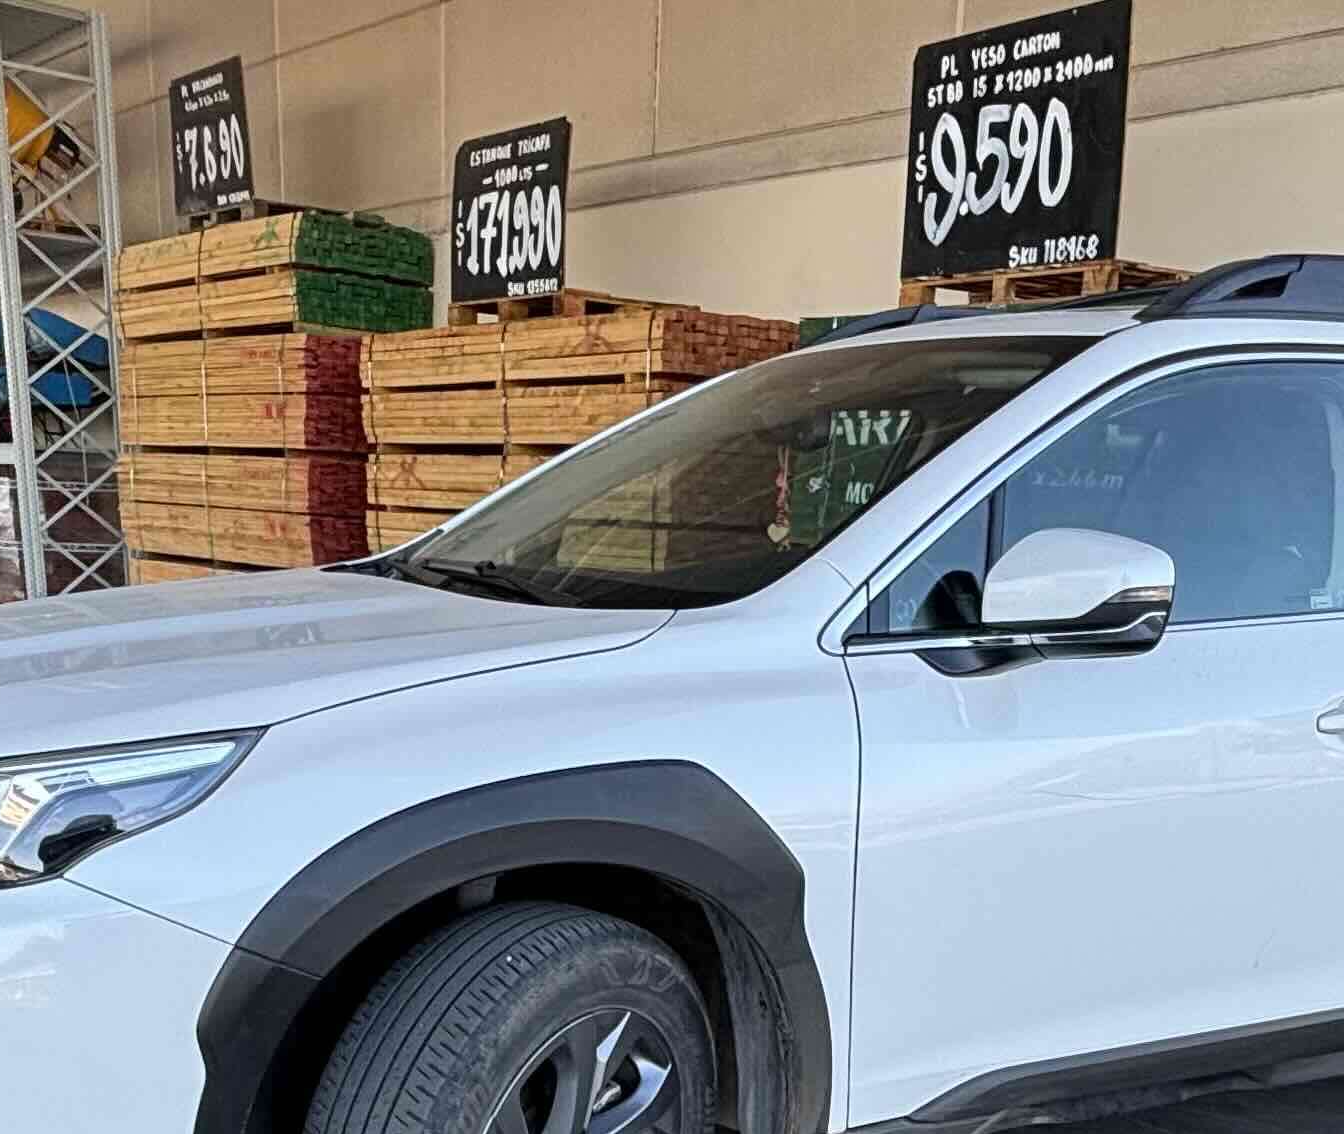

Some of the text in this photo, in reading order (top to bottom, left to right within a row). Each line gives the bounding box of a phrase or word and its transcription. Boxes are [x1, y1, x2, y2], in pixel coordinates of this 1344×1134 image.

[941, 32, 1060, 79] PL YESO CARTON
